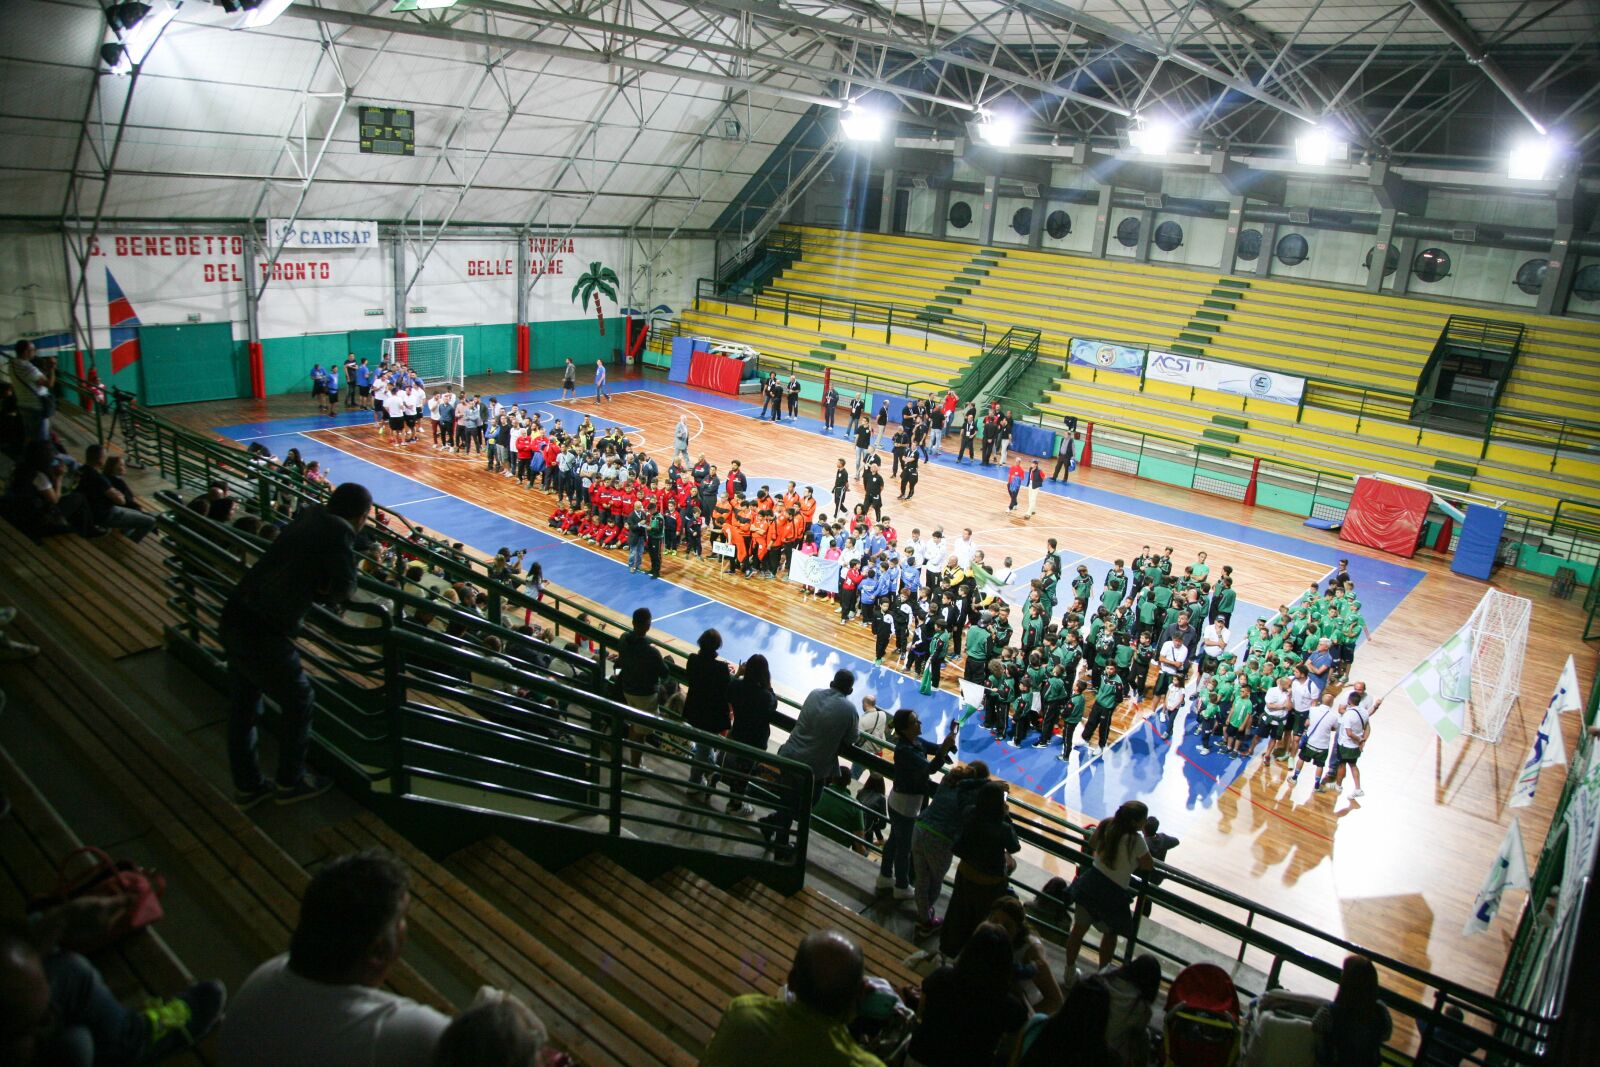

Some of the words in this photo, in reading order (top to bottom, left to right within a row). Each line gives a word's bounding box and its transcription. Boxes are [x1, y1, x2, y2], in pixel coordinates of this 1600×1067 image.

[115, 236, 243, 256] BENEDETTO
[300, 231, 371, 244] CARISAP
[204, 264, 243, 282] DEL
[259, 262, 330, 281] TRONTO
[468, 260, 513, 276] DELLE
